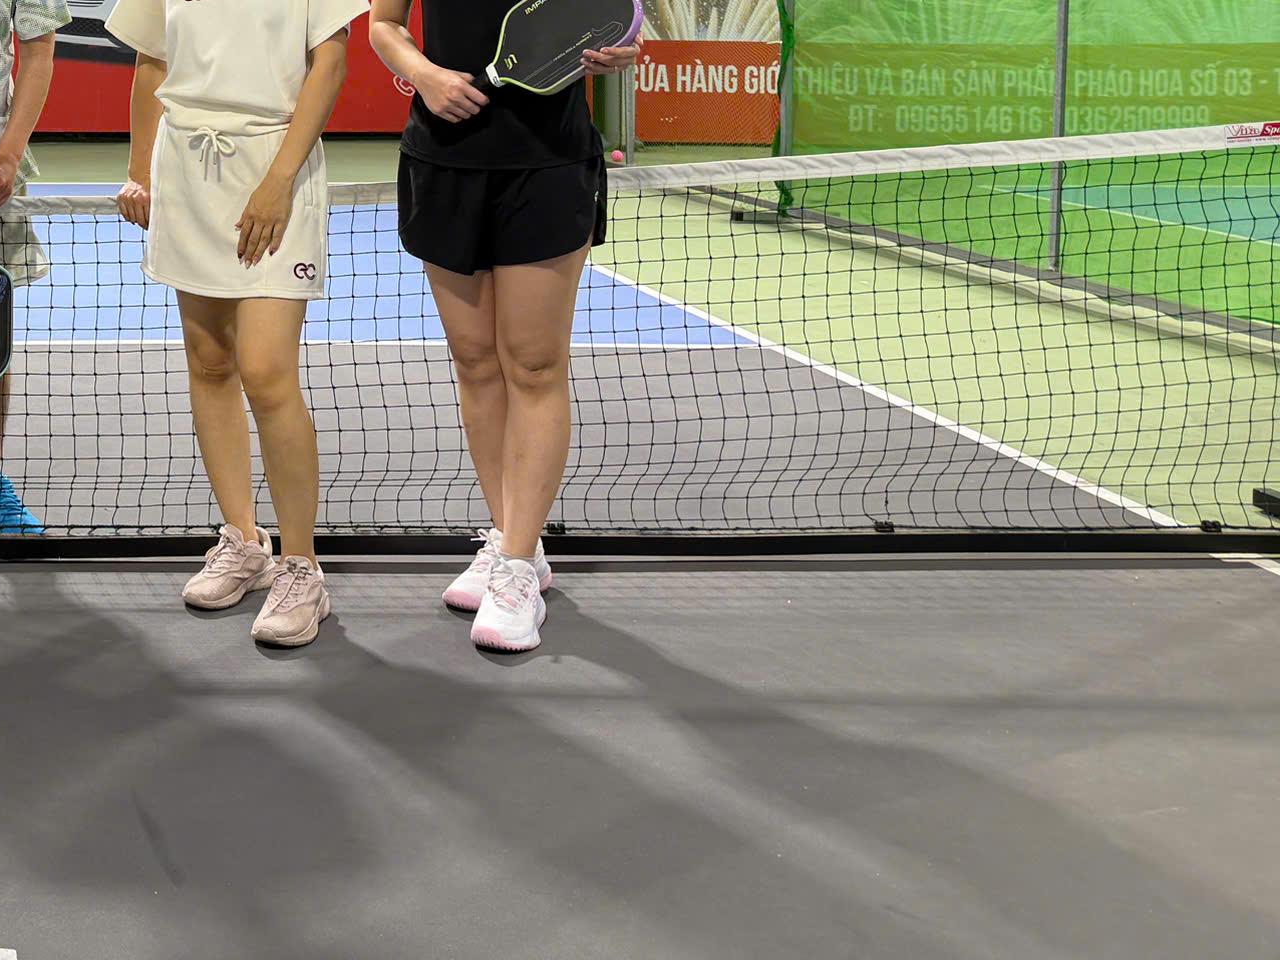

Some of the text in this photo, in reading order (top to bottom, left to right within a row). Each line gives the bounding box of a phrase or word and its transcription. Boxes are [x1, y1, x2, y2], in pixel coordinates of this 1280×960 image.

[676, 58, 738, 94] HÀNG
[744, 60, 781, 94] GIỚ
[1140, 68, 1184, 97] HOA
[1224, 67, 1252, 97] 03
